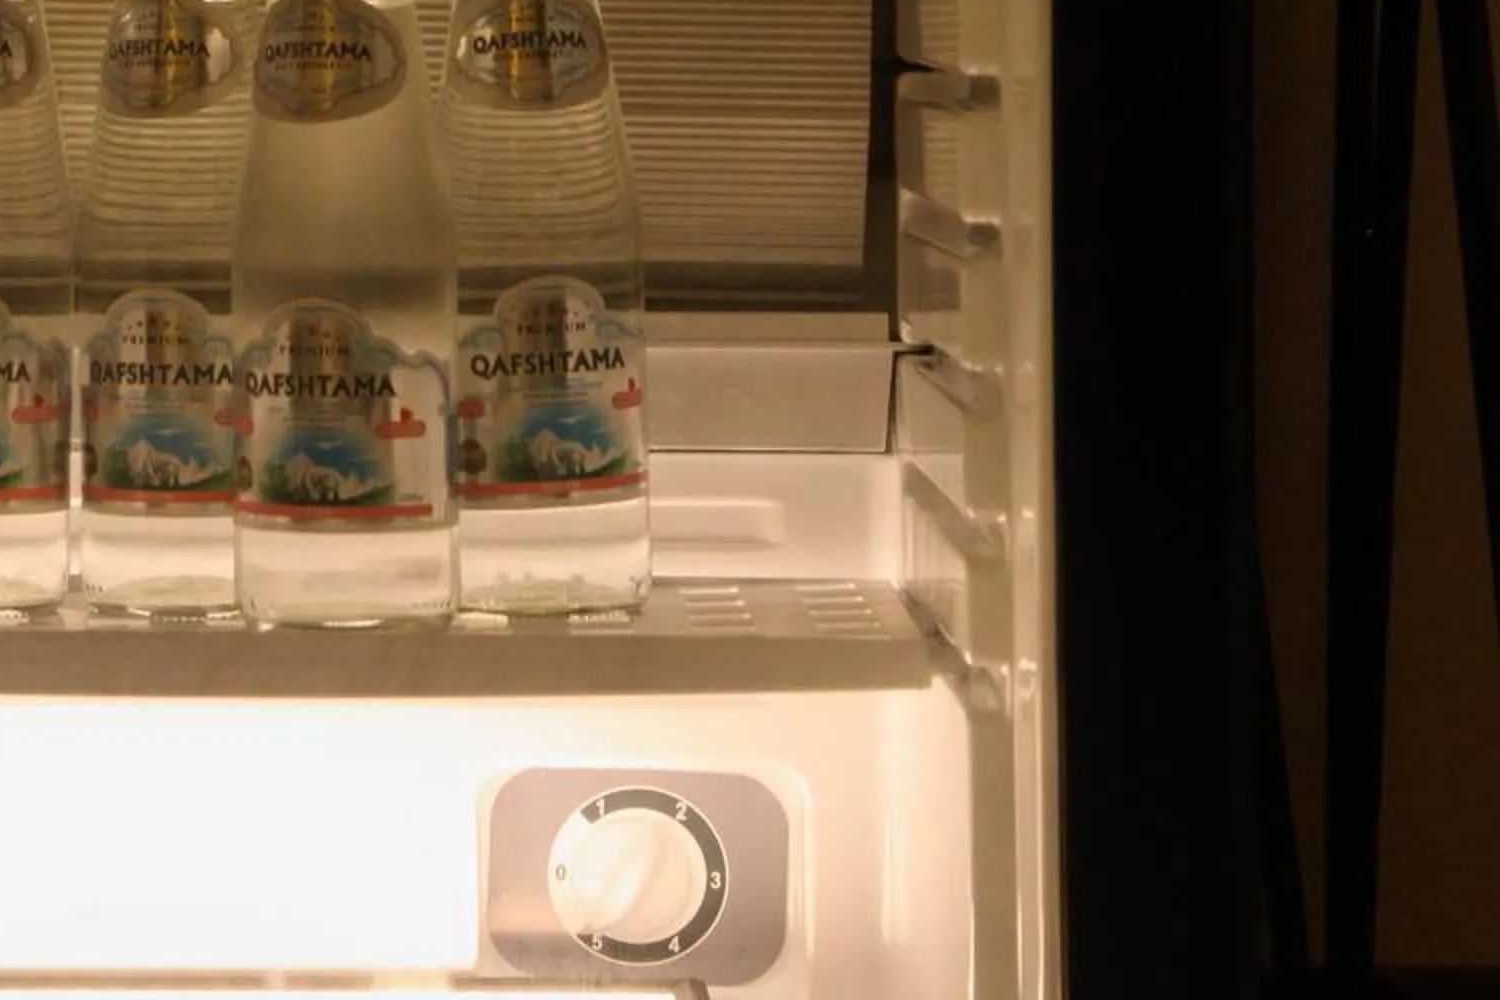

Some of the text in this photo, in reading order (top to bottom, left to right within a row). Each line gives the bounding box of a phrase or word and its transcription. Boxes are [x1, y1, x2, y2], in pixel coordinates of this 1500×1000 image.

[265, 41, 371, 62] QAFSHTAMA
[473, 29, 586, 54] QAFSHTAMA
[89, 360, 233, 386] QAFSHTAMA
[470, 346, 626, 380] QAFSHTAMA
[244, 370, 397, 398] QAFSHTAMA
[595, 799, 606, 817] 1
[675, 801, 688, 821] 2
[709, 871, 721, 889] 3
[667, 936, 680, 953] 4
